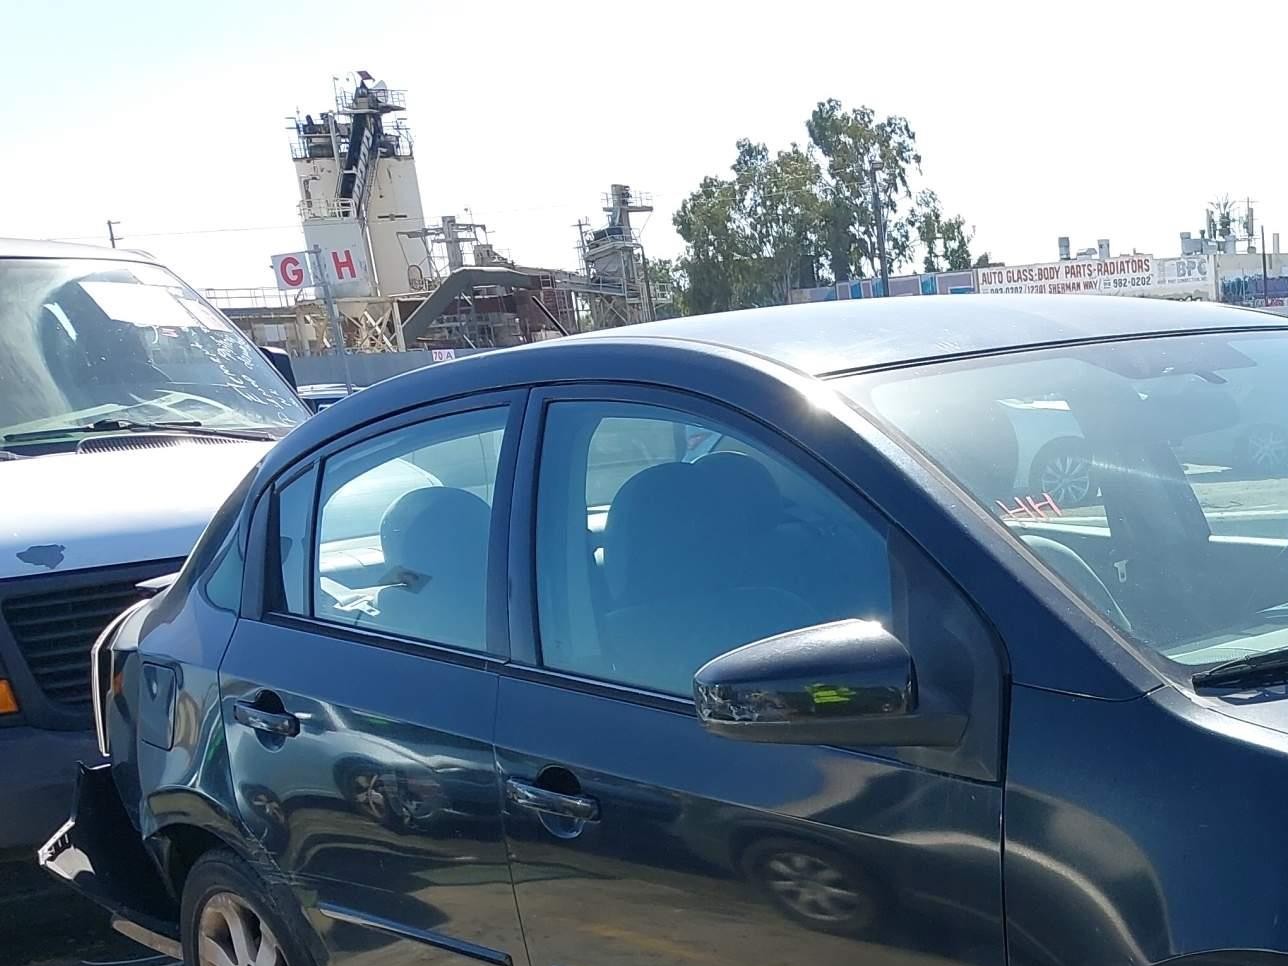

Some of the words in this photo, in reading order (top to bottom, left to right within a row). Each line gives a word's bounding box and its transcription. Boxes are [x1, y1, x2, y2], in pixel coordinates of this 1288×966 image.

[280, 256, 304, 287] G
[331, 249, 357, 280] H
[1176, 258, 1207, 277] BPC
[981, 271, 1003, 285] AUTO
[1048, 281, 1081, 294] SHERMAN
[1083, 280, 1098, 290] WAY
[446, 351, 453, 361] A
